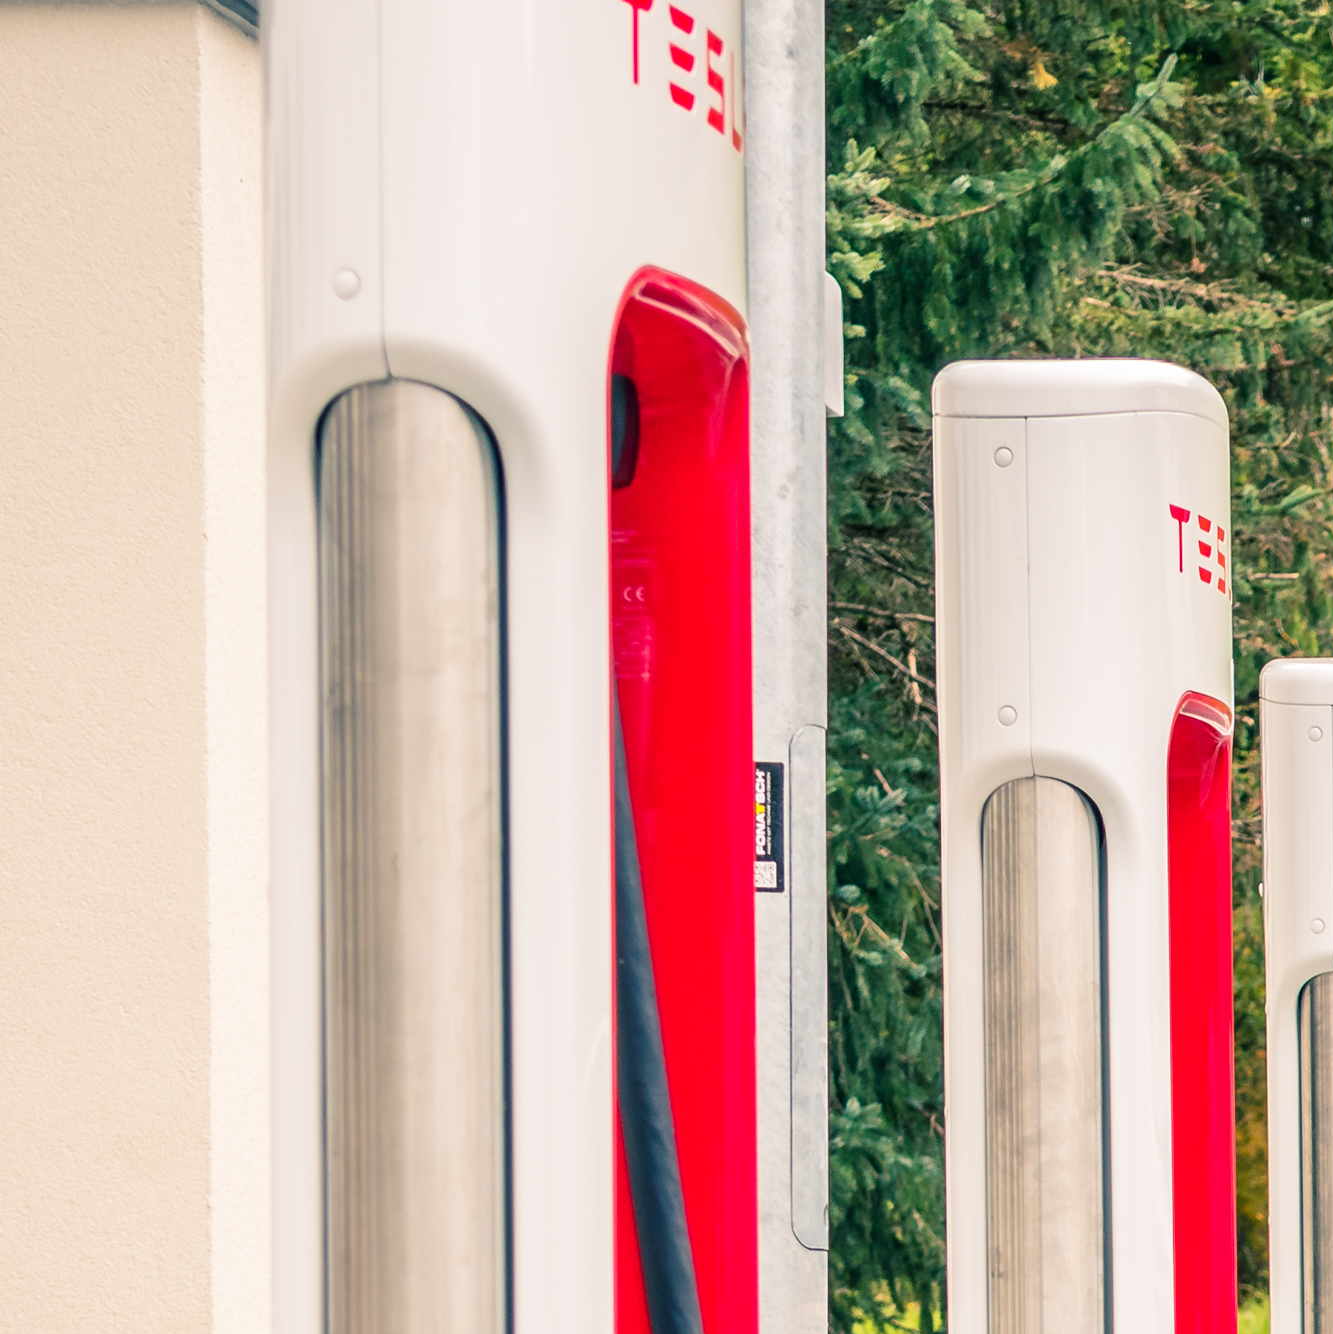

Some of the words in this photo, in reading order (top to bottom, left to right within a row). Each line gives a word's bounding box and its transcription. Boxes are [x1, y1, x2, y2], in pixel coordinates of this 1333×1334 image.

[621, 0, 743, 153] TESL
[1168, 503, 1231, 601] TES
[755, 770, 766, 856] FONATSCH
